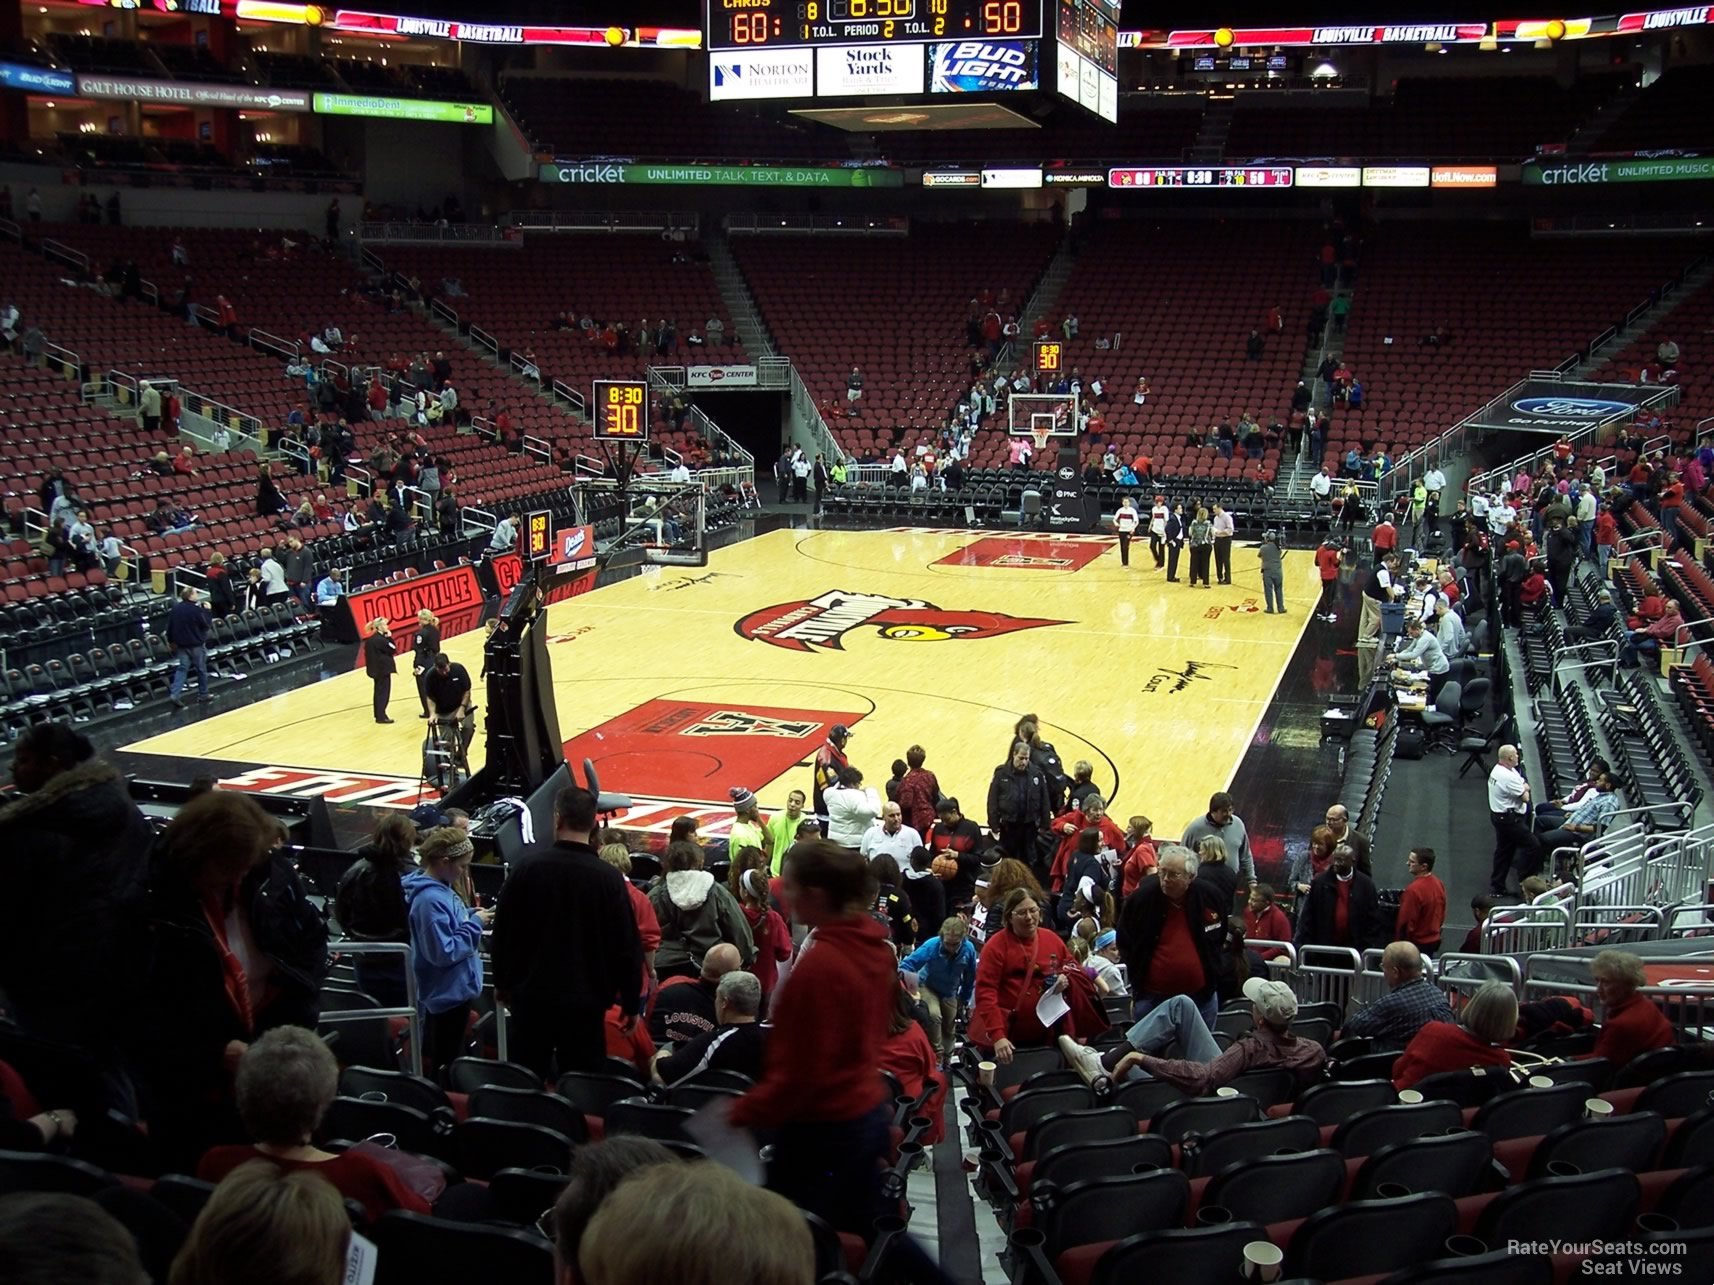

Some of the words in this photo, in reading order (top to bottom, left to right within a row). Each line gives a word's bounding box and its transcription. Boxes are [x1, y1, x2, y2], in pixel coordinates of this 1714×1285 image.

[807, 2, 818, 20] 8
[985, 2, 1021, 33] 50
[1643, 8, 1709, 29] LOUISVILLE
[396, 18, 450, 37] LOUISVILLE
[457, 24, 523, 42] BASKETBALL
[734, 13, 767, 43] 60
[812, 26, 837, 37] T.O.L.
[844, 24, 879, 36] PERIOD
[884, 20, 895, 38] 2
[905, 22, 930, 34] T.O.L.
[934, 17, 945, 35] 2
[1312, 28, 1375, 43] LOUISVILLE
[1382, 26, 1457, 42] BASKETBALL
[847, 48, 892, 61] Stock
[953, 43, 1026, 66] BUD
[750, 64, 808, 76] NORTON
[848, 62, 892, 75] Yards
[942, 60, 1027, 82] LIGHT
[82, 80, 111, 94] GALT
[114, 82, 153, 97] HOUSE
[155, 85, 193, 100] HOTEL
[559, 165, 625, 183] cricket
[648, 170, 712, 180] UNLIMITED
[715, 171, 747, 182] TALK,
[751, 172, 783, 182] TEXT,
[787, 173, 794, 181] &
[797, 173, 829, 182] DATA
[1542, 163, 1608, 184] cricket
[1618, 165, 1673, 176] UNLIMITED
[1676, 164, 1708, 174] MUSIC
[1040, 354, 1057, 369] 30
[609, 387, 642, 403] 8:30
[1533, 400, 1612, 416] Ford
[607, 404, 638, 433] 30
[532, 532, 543, 551] 30
[363, 573, 472, 625] LOUISVILLE
